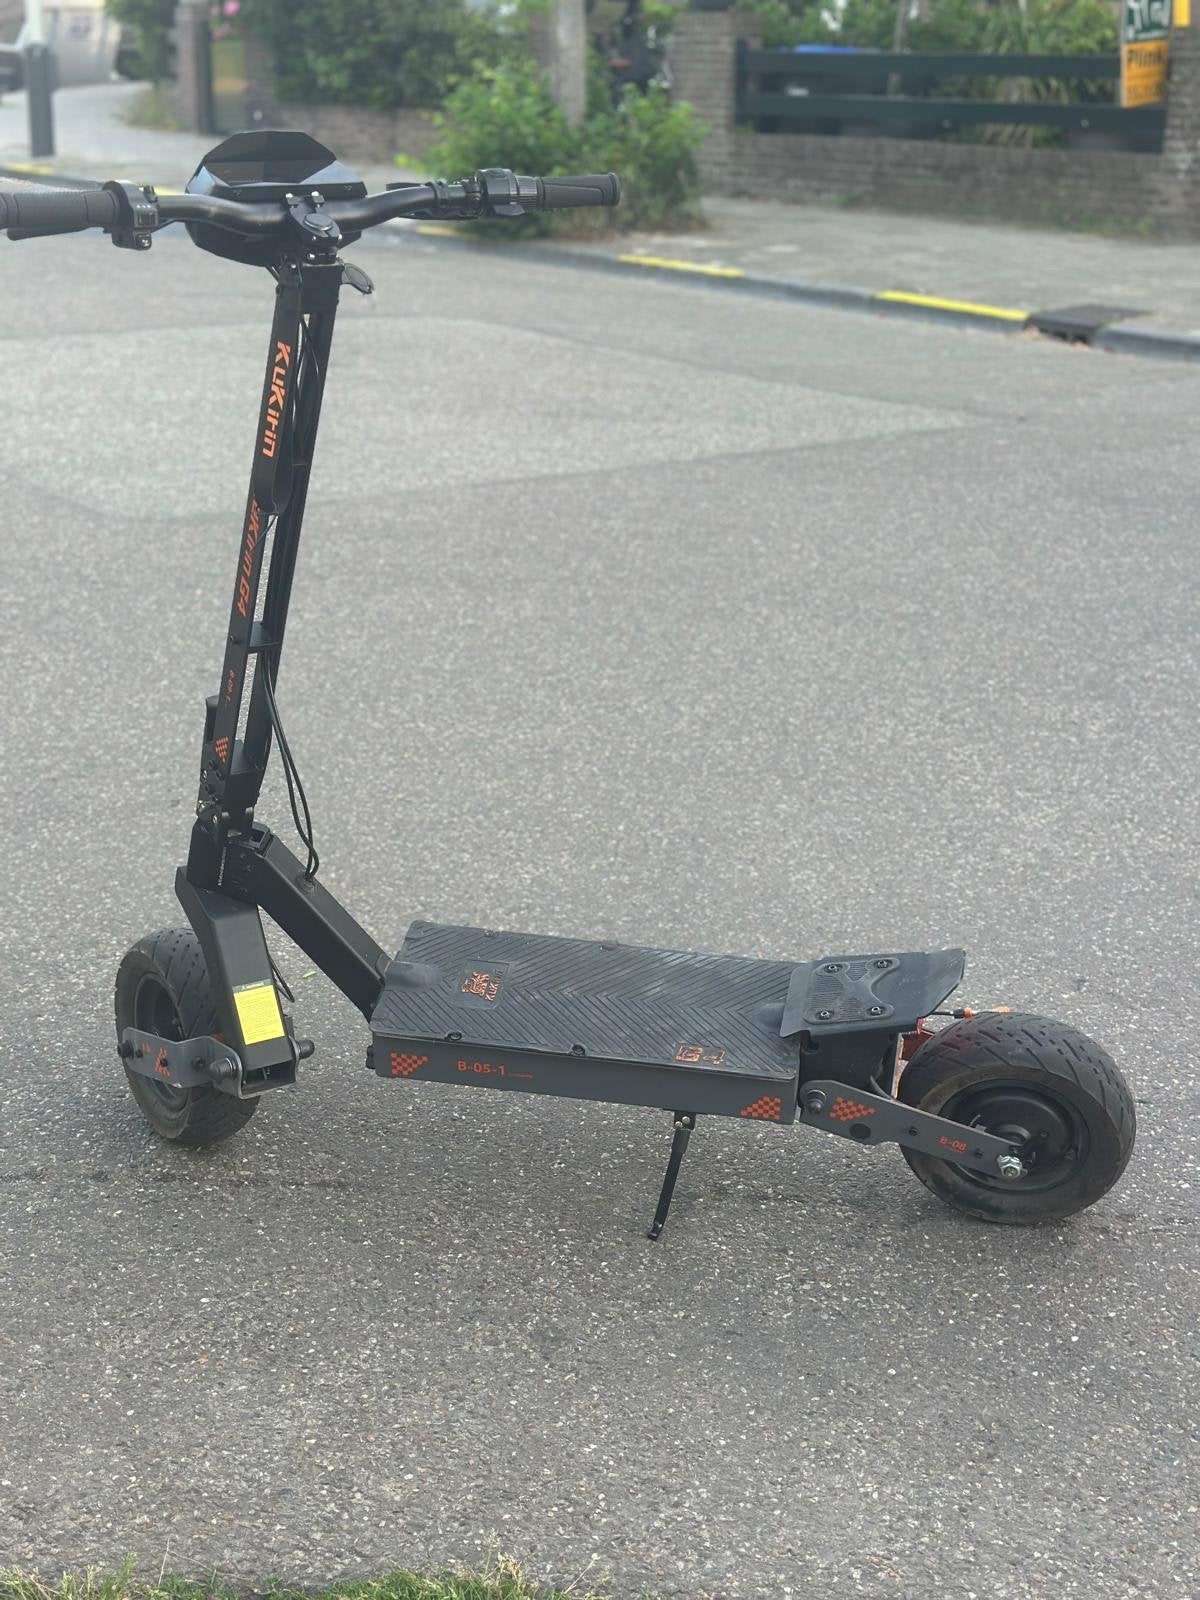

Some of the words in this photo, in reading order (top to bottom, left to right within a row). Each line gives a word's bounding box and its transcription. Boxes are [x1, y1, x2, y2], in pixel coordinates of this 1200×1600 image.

[262, 341, 291, 458] KuKirin
[242, 499, 259, 577] uKirin
[236, 575, 250, 617] G4
[457, 1060, 505, 1077] B-05-1
